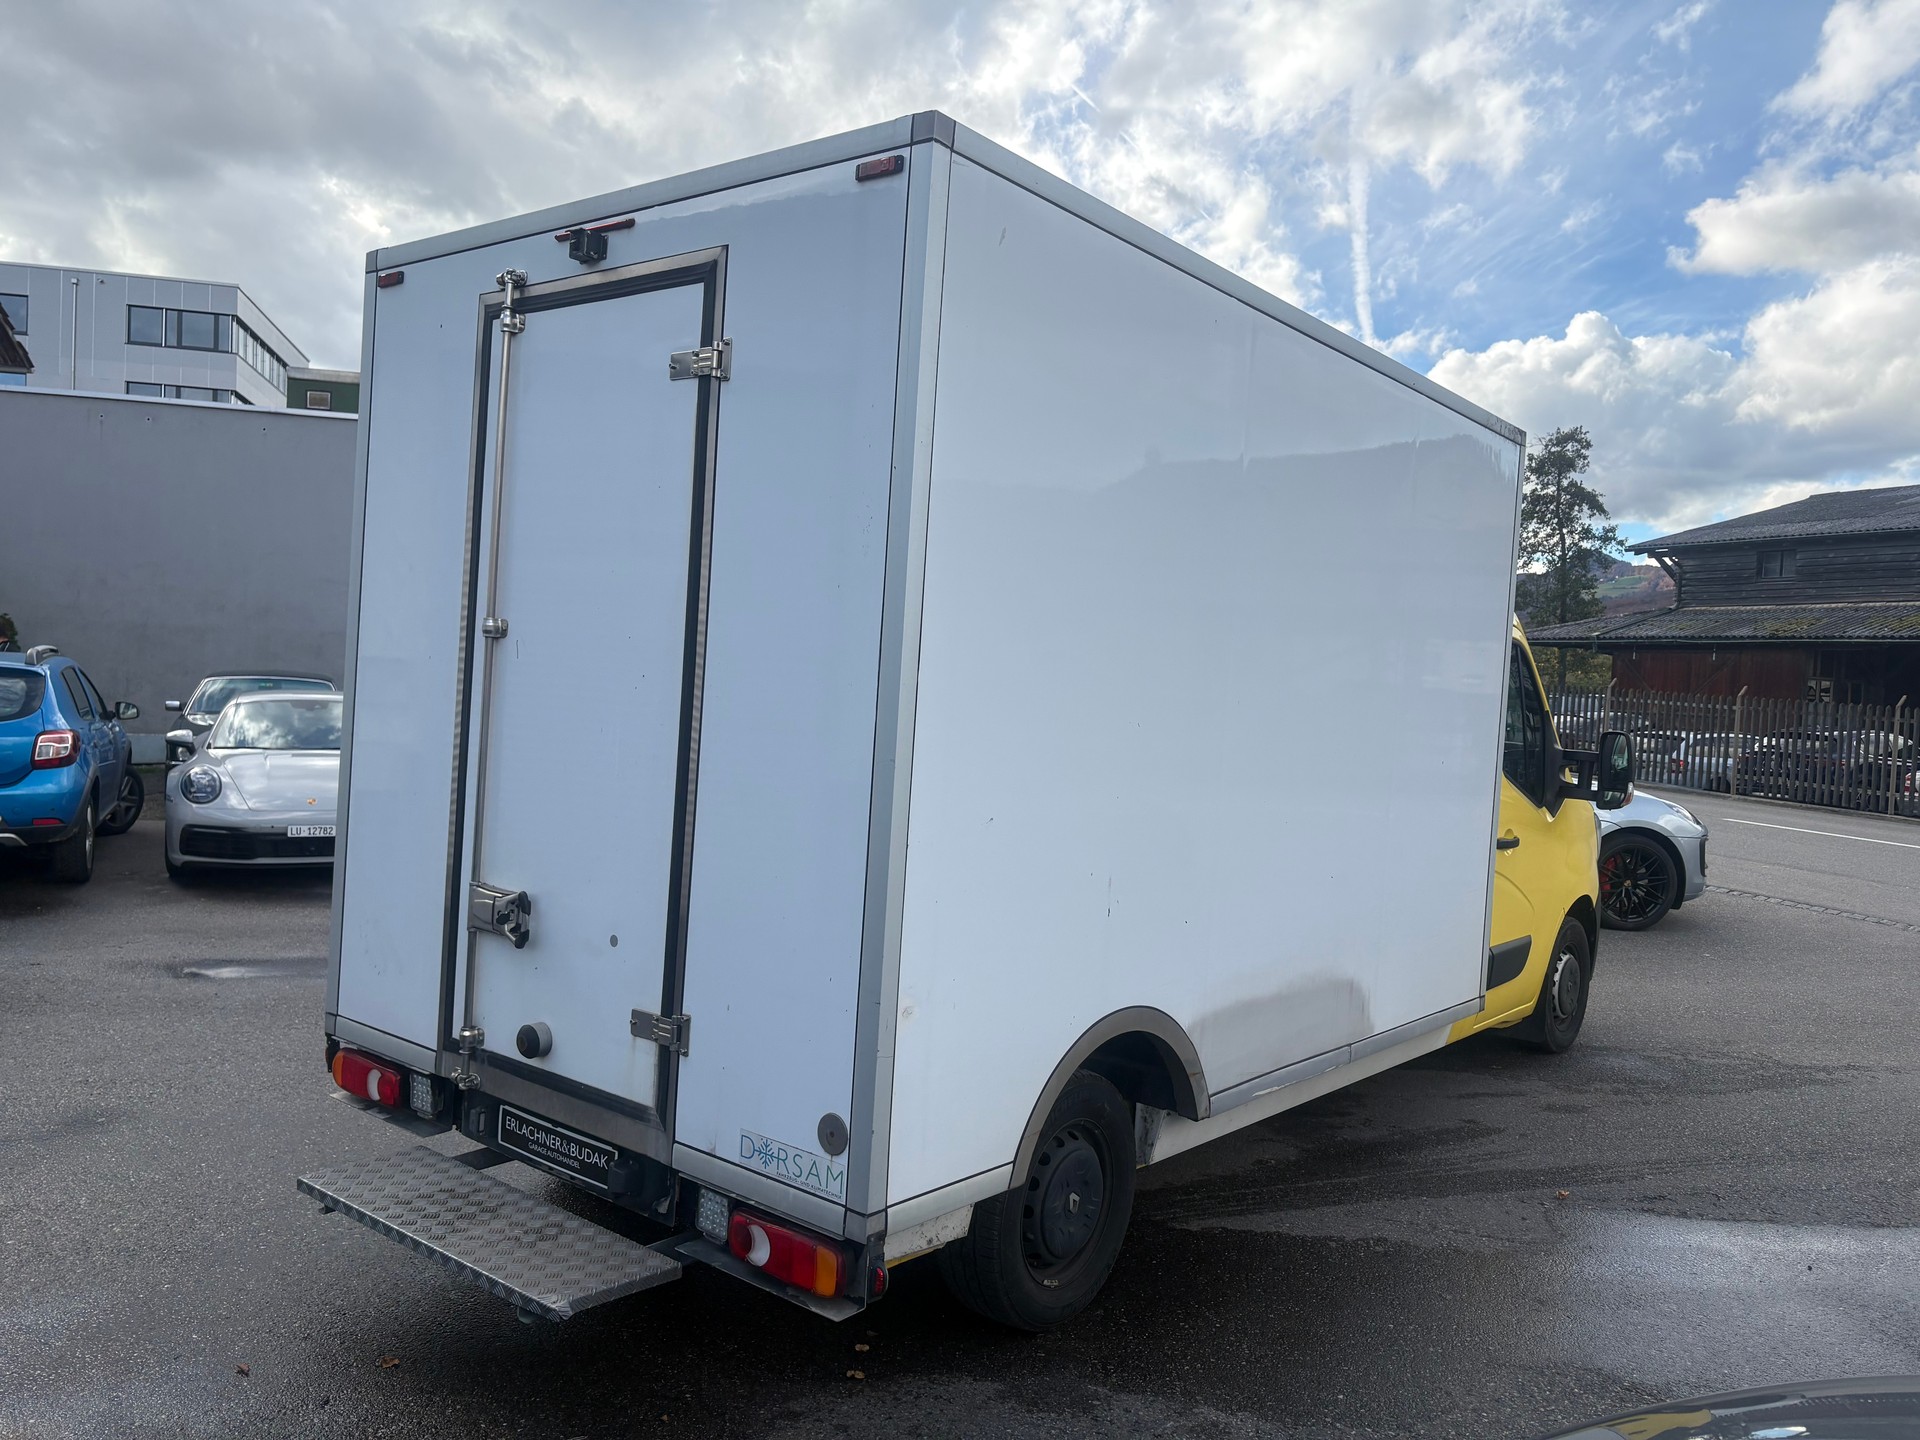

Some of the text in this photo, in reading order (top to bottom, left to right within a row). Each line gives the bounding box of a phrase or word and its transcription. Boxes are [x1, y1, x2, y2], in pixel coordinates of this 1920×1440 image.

[505, 1115, 608, 1170] ERLACHNER&BUDAK
[528, 1142, 580, 1169] GARAGE AUTOHANDEL
